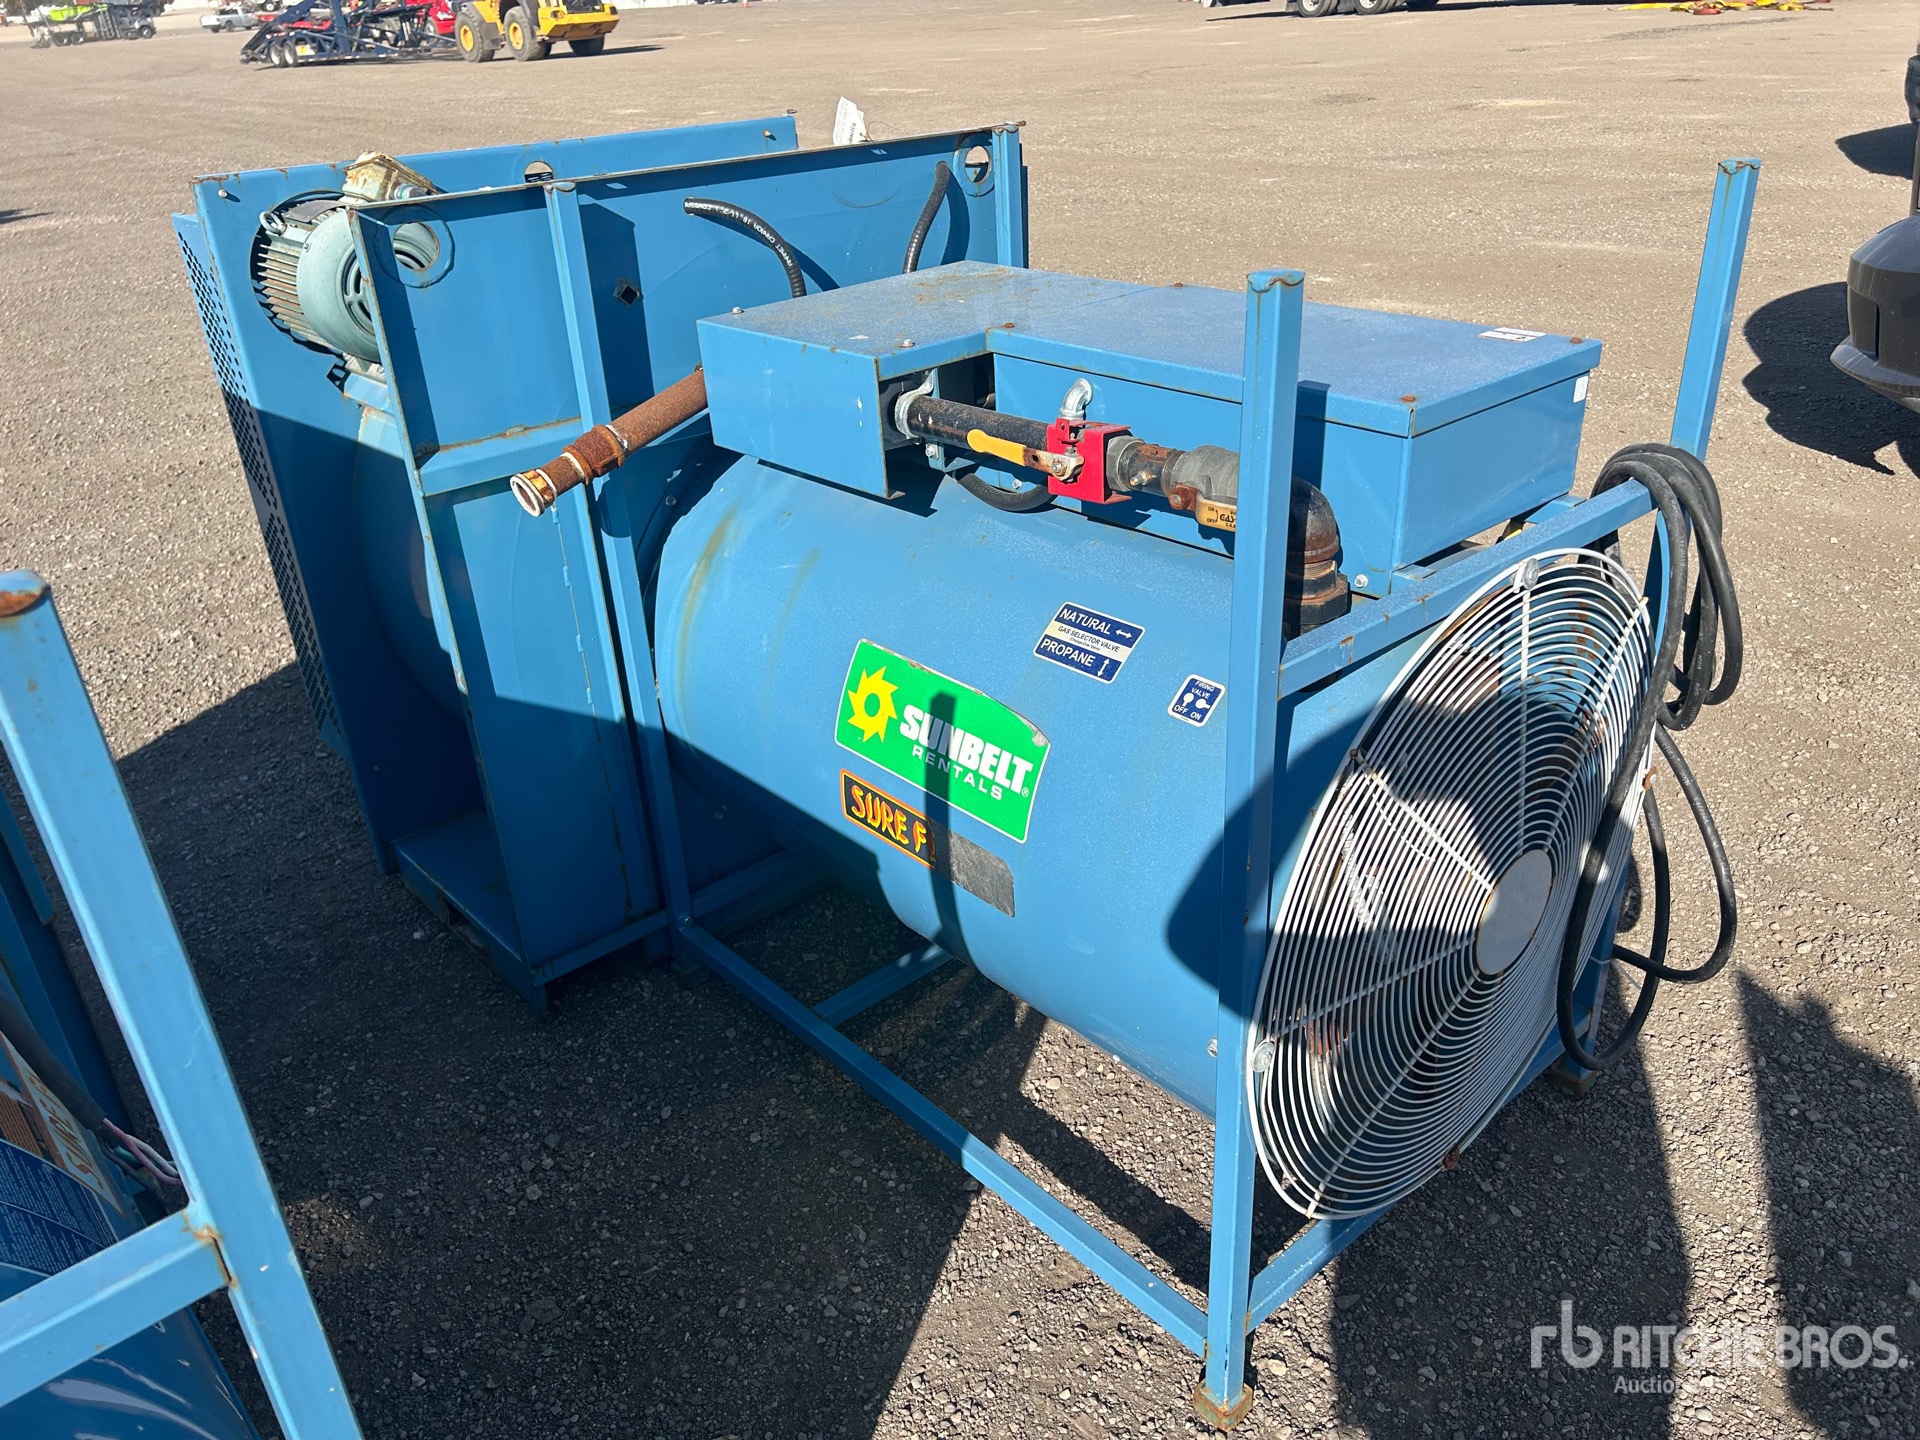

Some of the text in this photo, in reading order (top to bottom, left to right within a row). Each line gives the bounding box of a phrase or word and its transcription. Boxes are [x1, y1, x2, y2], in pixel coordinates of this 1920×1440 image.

[1059, 607, 1112, 636] NATURAL
[1040, 637, 1096, 667] PROPANE
[1058, 625, 1121, 653] GAS SELECTOR VALVE
[1191, 687, 1211, 700] VALVE
[1194, 680, 1215, 692] FIRING
[1174, 704, 1189, 714] OFF
[1190, 711, 1202, 721] ON
[911, 745, 1004, 802] RENTALS
[850, 784, 910, 846] SURE
